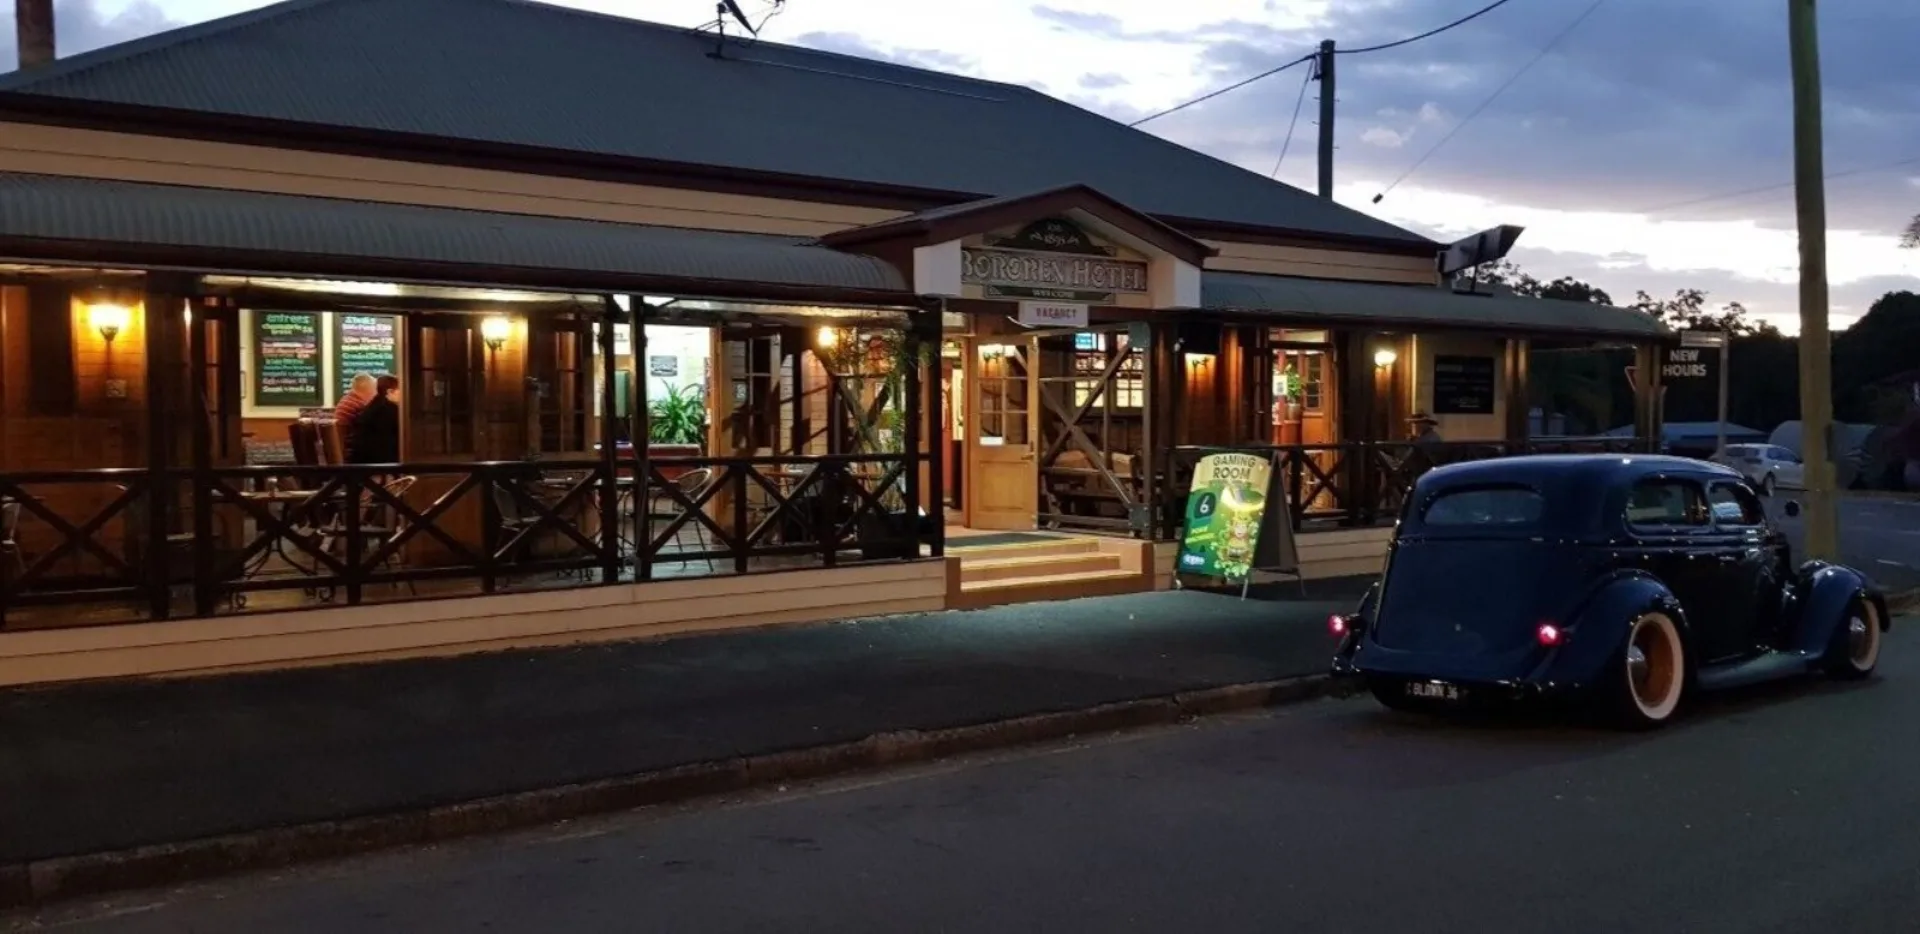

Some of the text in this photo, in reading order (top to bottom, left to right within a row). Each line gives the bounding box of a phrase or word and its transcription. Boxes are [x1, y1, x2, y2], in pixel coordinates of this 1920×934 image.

[1073, 260, 1146, 289] HOTEL
[1036, 307, 1077, 318] VACANCY
[1669, 349, 1700, 361] NEW
[1662, 364, 1707, 376] HOURS
[1213, 454, 1257, 468] GAMING
[1213, 467, 1250, 479] ROOM
[1200, 495, 1210, 513] 6
